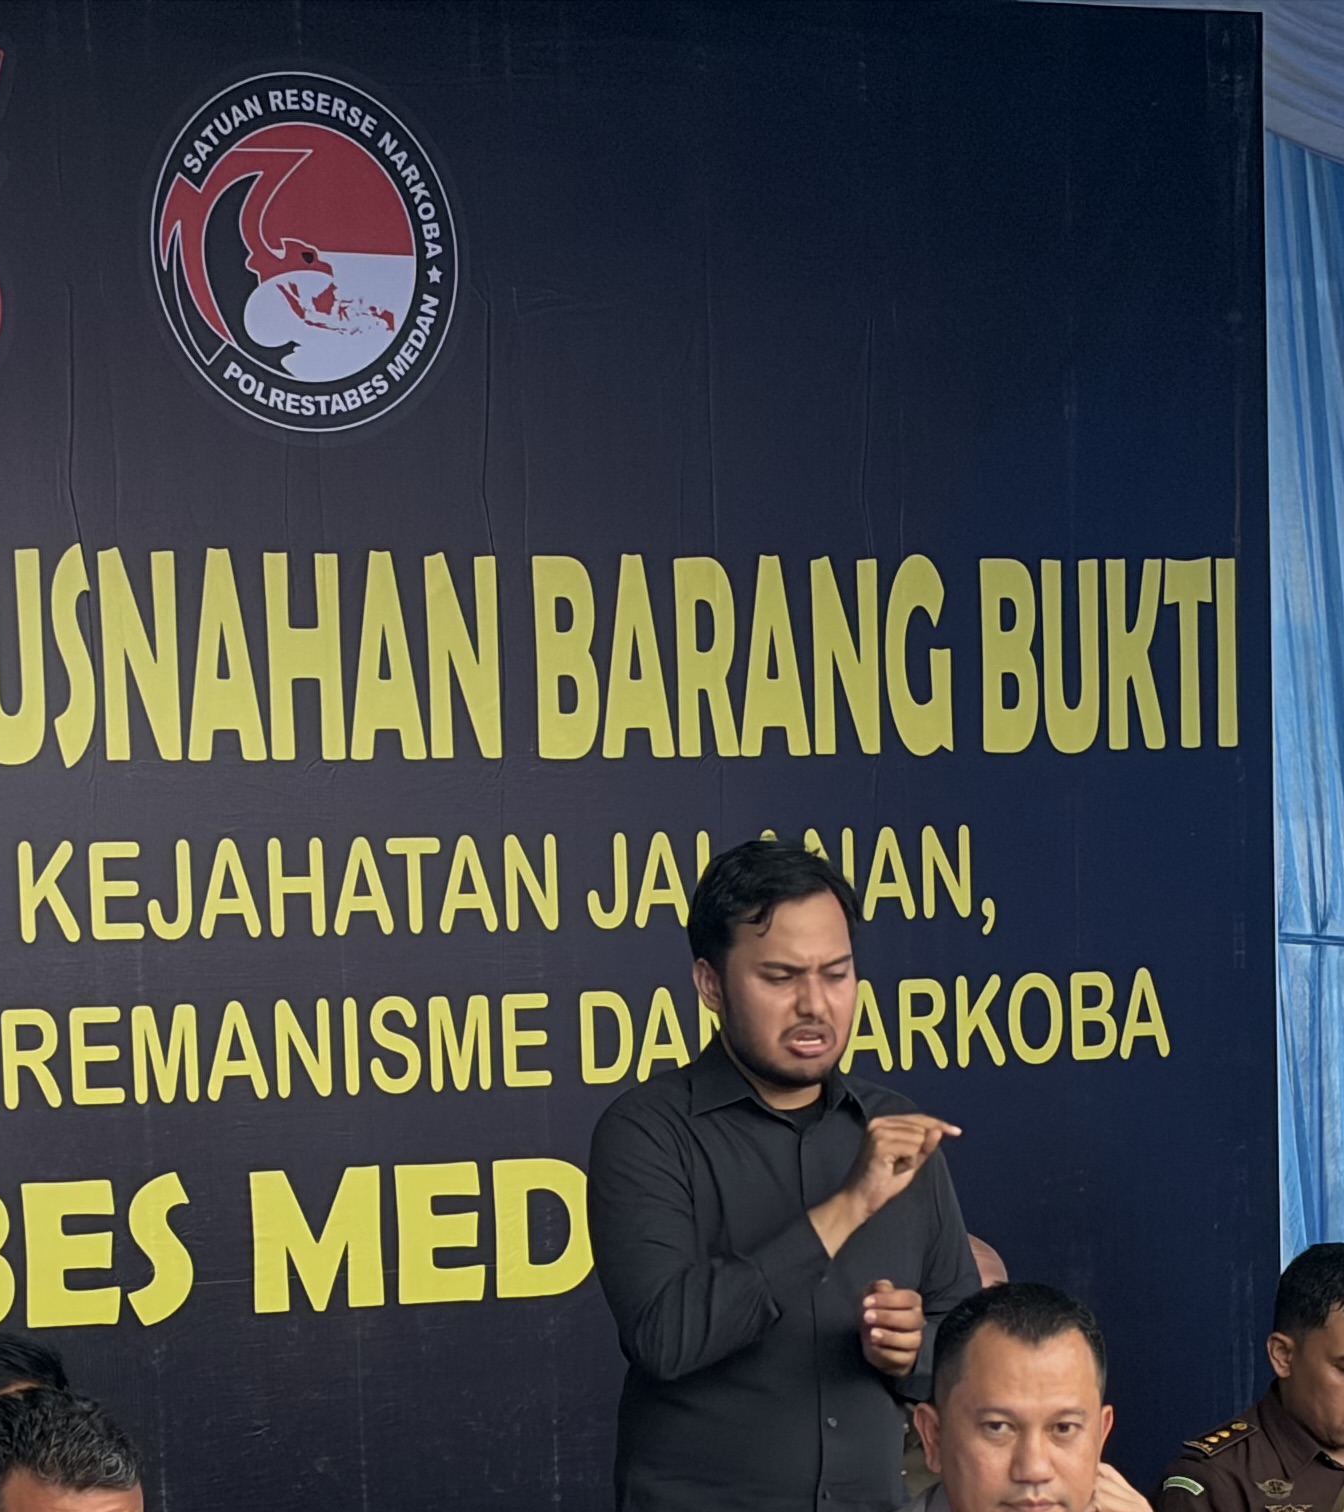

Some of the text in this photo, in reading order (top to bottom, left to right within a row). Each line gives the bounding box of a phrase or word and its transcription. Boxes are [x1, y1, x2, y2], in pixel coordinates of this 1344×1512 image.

[183, 88, 443, 260] SATUAN RESERSE NARKOBA
[223, 292, 440, 416] POLRESTABES MEDAN
[531, 555, 955, 760] BARANG
[979, 558, 1239, 754] BUKTI
[16, 834, 560, 945] KEJAHATAN
[586, 824, 997, 935] JAAN,
[839, 968, 1171, 1075] ARKOBA
[249, 1158, 595, 1314] MED
